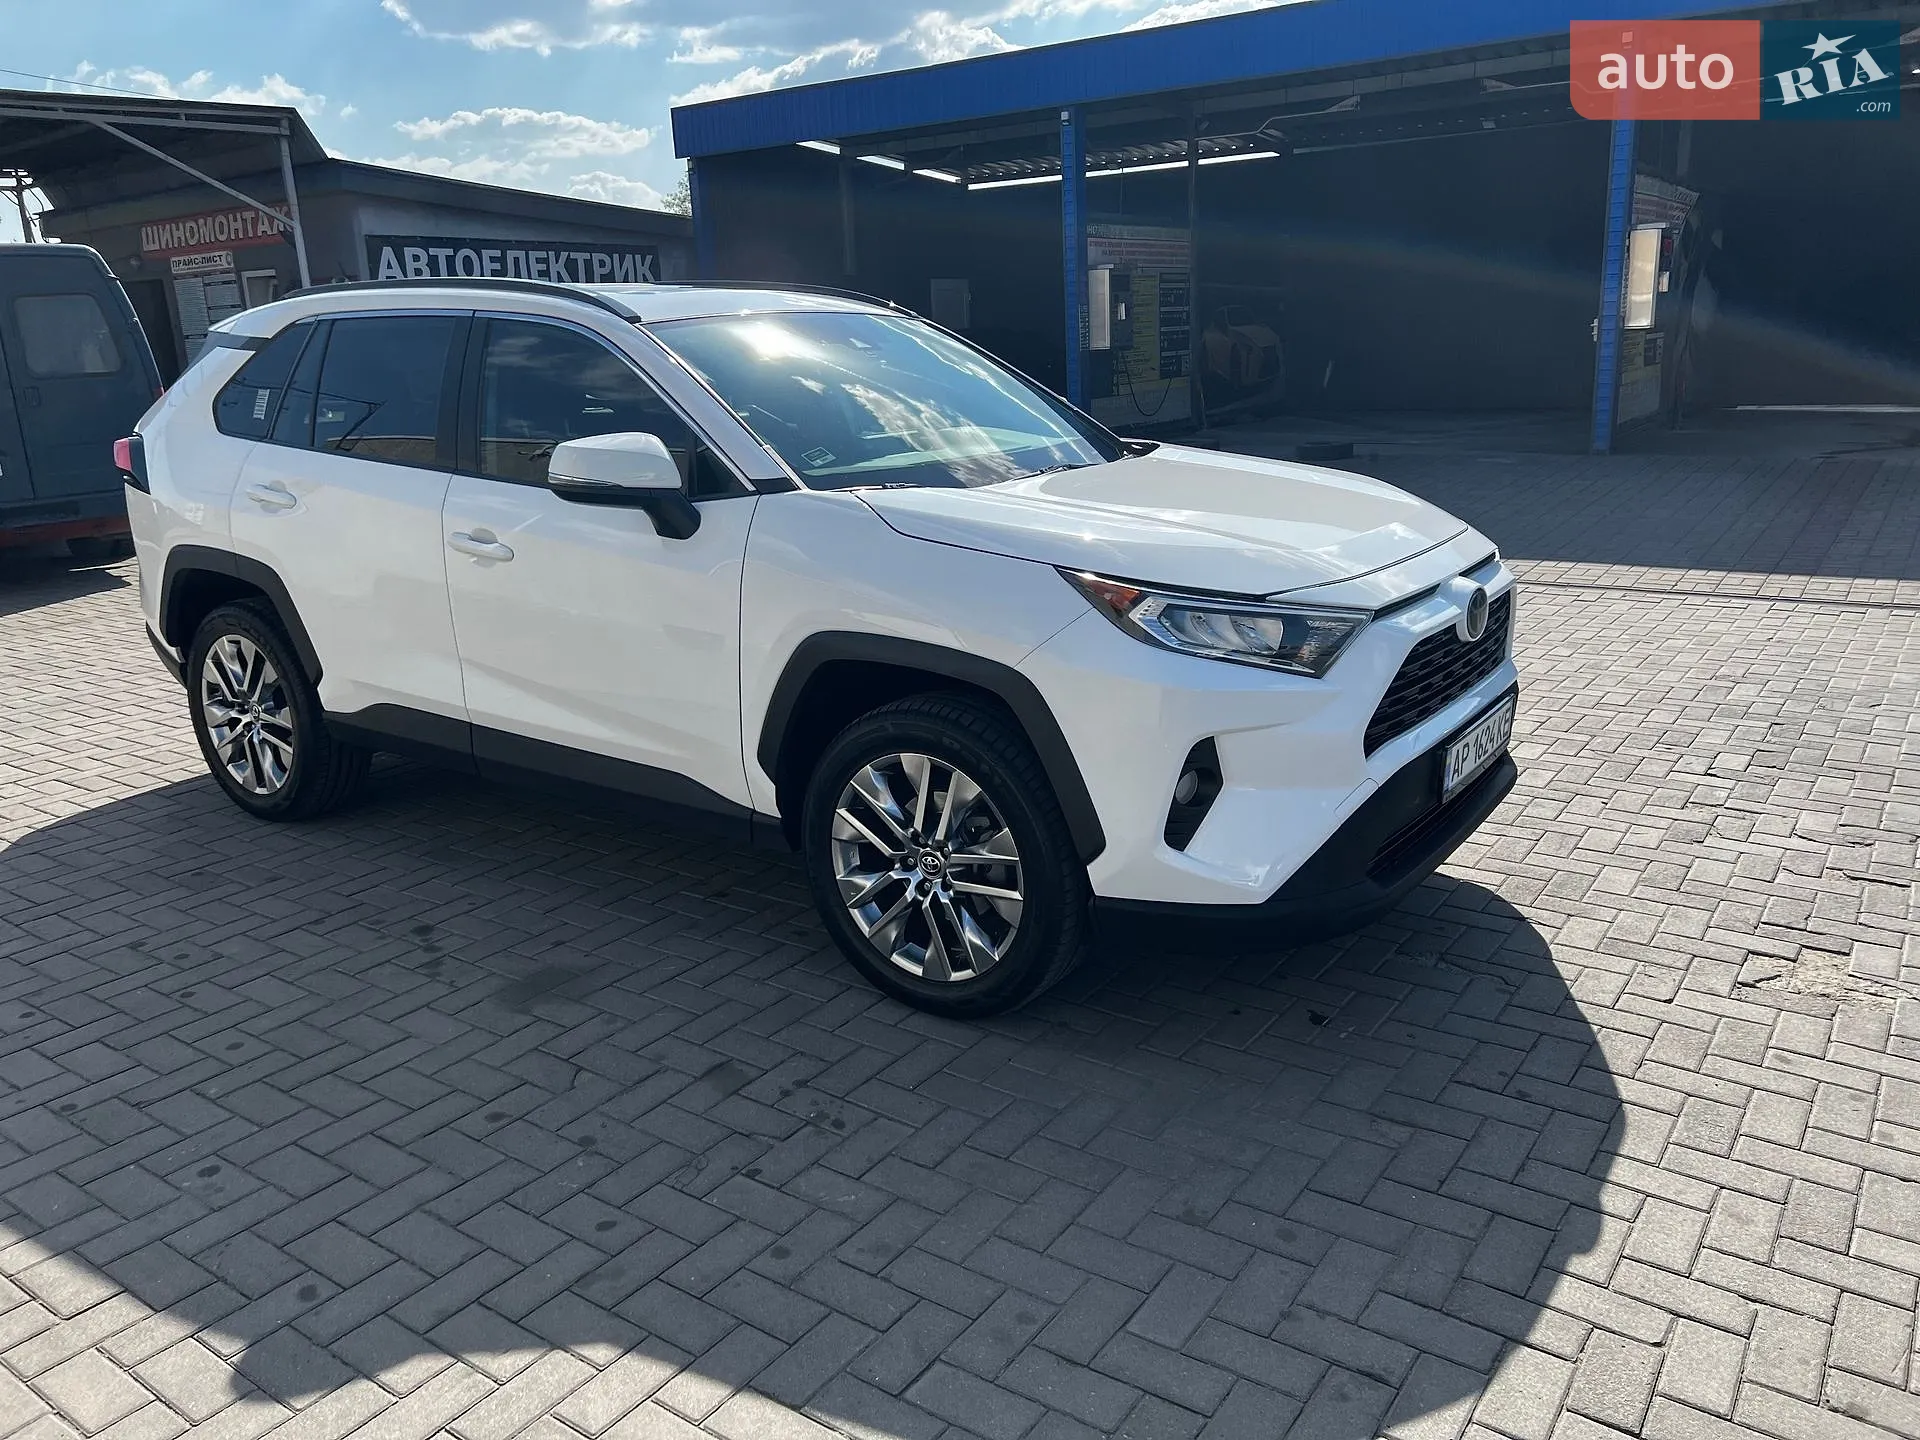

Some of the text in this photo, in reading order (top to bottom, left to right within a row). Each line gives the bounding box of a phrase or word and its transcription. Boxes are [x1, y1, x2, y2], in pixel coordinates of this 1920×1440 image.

[171, 254, 224, 269] ПРАЙС-ЛИСТ
[377, 246, 656, 283] АВТОЕЛЕКТРИК
[1451, 742, 1470, 782] AP
[1473, 718, 1497, 765] 1624
